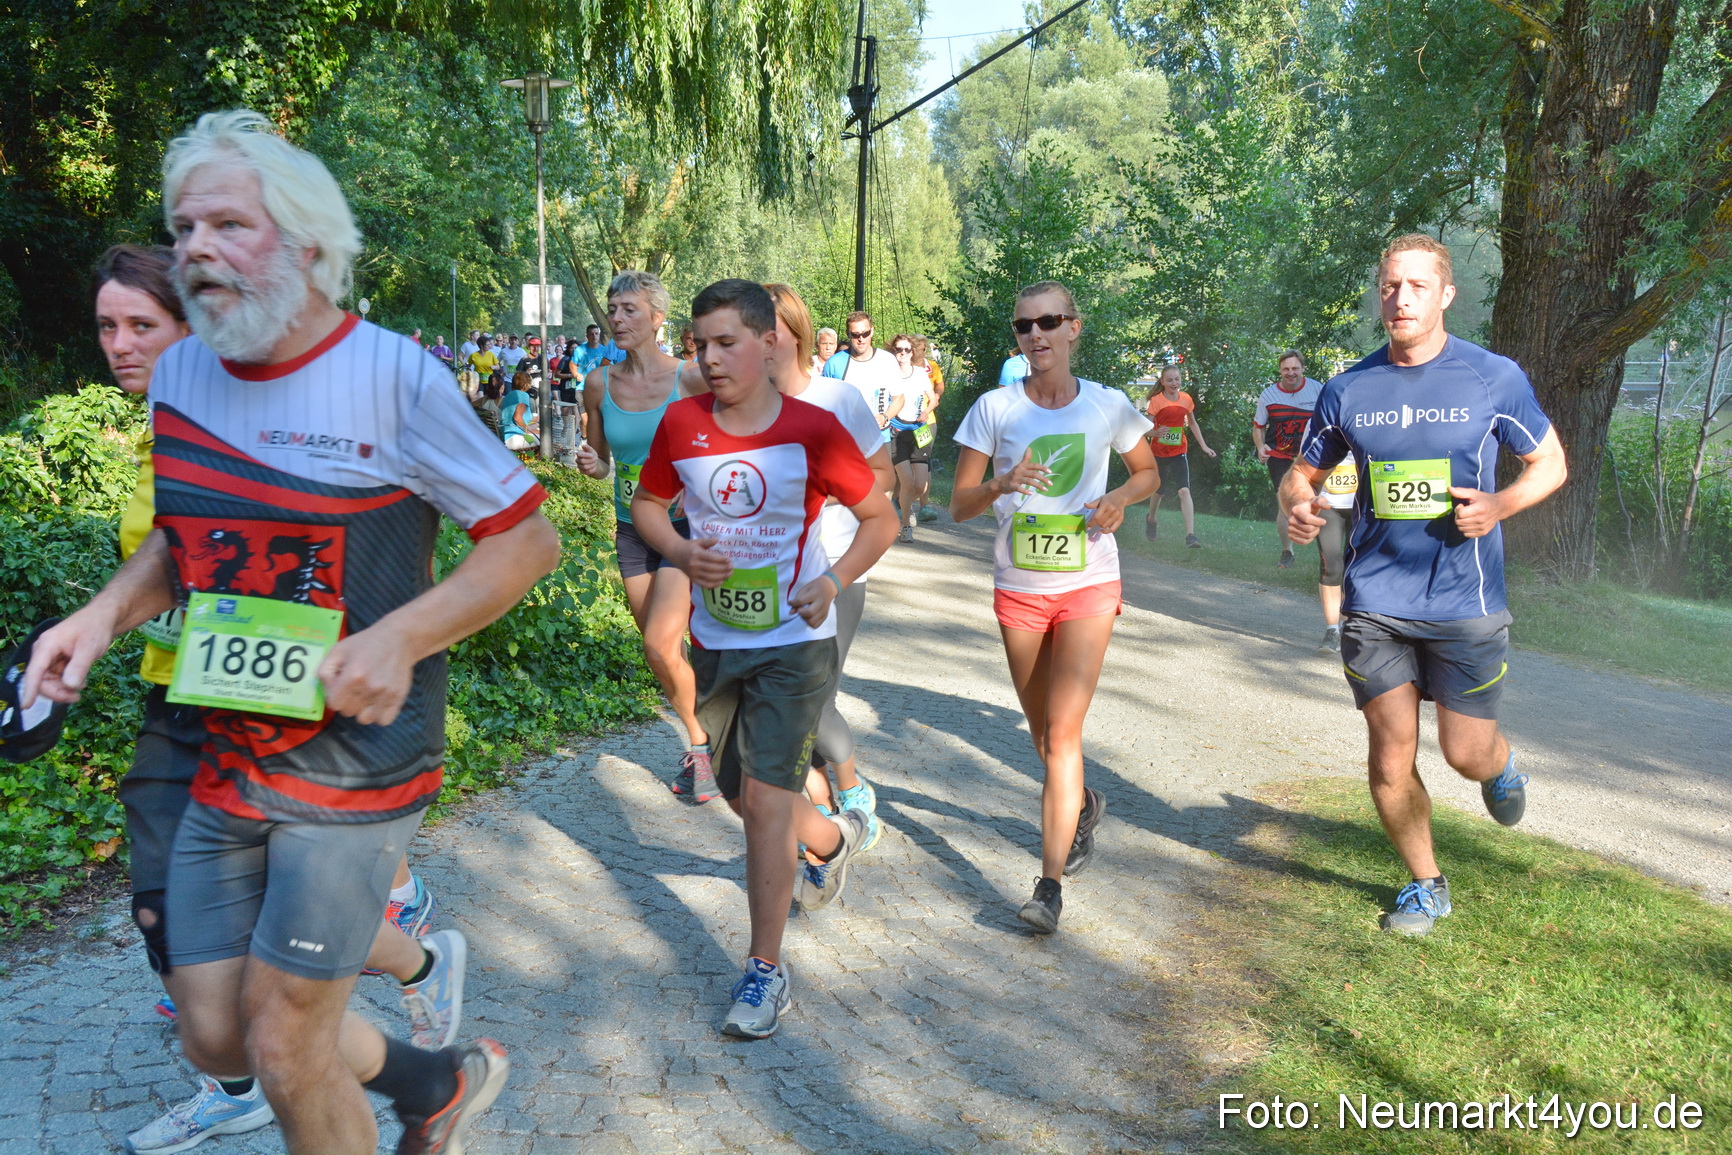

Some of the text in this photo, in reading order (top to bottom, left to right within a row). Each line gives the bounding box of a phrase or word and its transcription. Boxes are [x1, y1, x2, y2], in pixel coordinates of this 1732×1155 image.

[1355, 407, 1470, 427] EURO POLES
[257, 430, 355, 453] NEUMARKT
[1329, 474, 1357, 486] 1823
[1387, 481, 1431, 502] 529
[701, 520, 787, 536] LAUFEN MIT HERZ
[1028, 534, 1068, 554] 172
[707, 588, 767, 612] 1558
[199, 634, 309, 683] 1886
